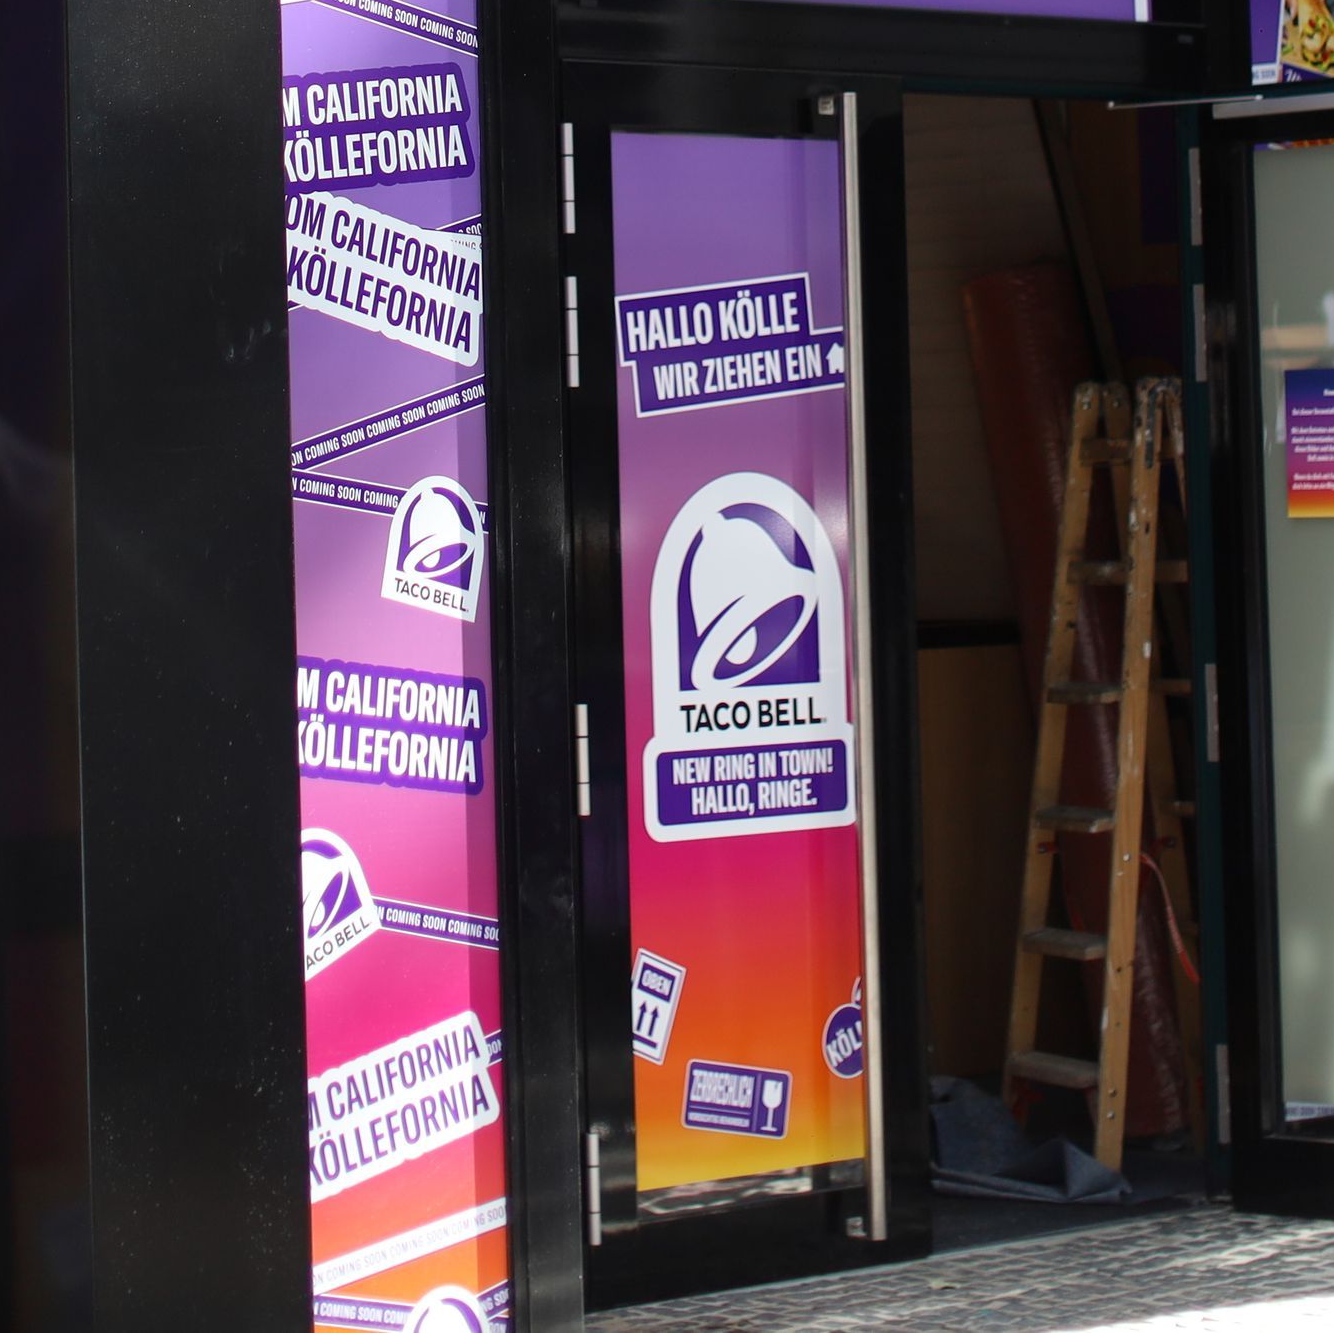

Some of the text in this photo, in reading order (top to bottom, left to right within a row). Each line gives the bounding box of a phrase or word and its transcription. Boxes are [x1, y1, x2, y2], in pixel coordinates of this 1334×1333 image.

[395, 8, 419, 28] SOON
[420, 17, 454, 40] COMING
[306, 73, 463, 126] CALIFORNIA
[330, 209, 481, 302] CALIFORNIA
[287, 245, 471, 354] KÖLLEFORNIA
[626, 289, 800, 353] HALLO KÖLLE
[653, 343, 822, 400] WIR ZIEHEN EIN
[291, 383, 485, 466] ON COMING SOON COMING SOON COMING SOON
[299, 478, 335, 498] COMING
[337, 484, 362, 502] SOON
[363, 489, 399, 508] COMING
[394, 577, 468, 613] TACO BELL
[326, 670, 481, 729] CALIFORNIA
[680, 697, 822, 733] TACO BELL
[672, 747, 833, 785] NEW RING IN TOWN!
[691, 778, 818, 816] HALLO, RINGE.
[305, 915, 370, 970] ACO BELL
[386, 908, 421, 927] COMING
[422, 914, 447, 932] SOON
[448, 919, 482, 938] COMING
[326, 1024, 481, 1121] CALIFORNIA
[320, 1303, 357, 1318] COMING
[358, 1306, 383, 1323] SOON
